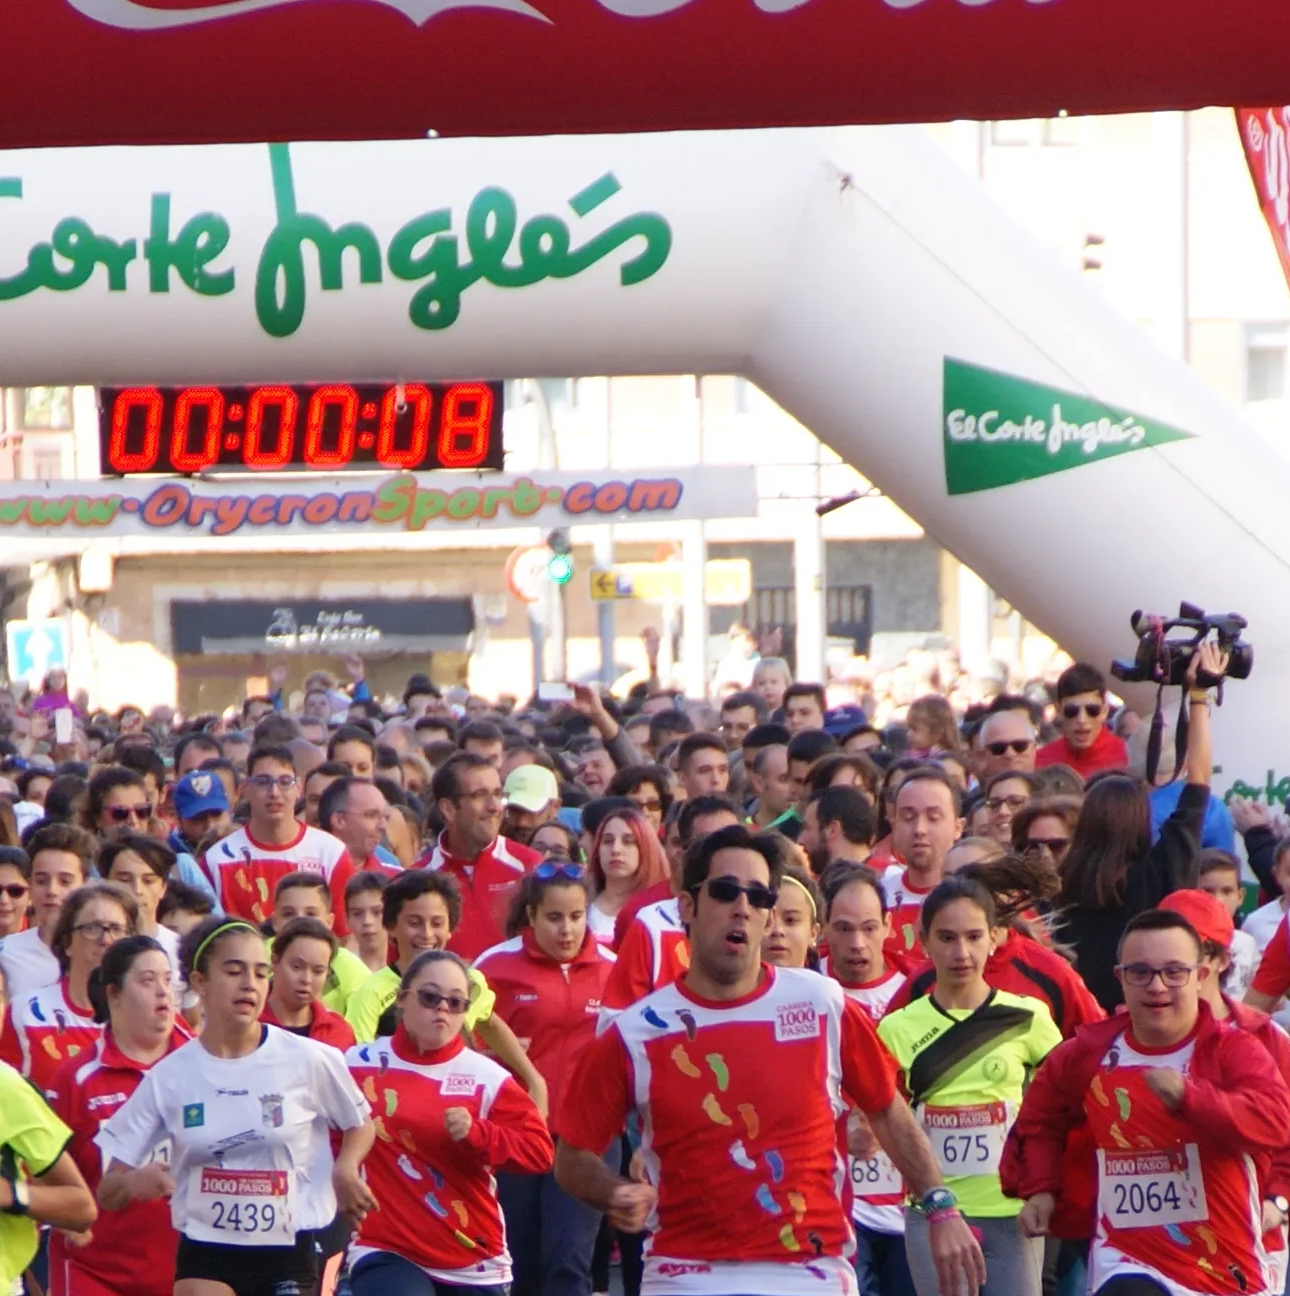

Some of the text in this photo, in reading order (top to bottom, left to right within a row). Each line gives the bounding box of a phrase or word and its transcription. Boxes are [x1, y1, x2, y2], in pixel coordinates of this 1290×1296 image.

[253, 142, 672, 338] Inglés
[109, 383, 494, 472] 00:00:08
[946, 403, 1146, 455] El Corte Inglés
[776, 1009, 816, 1028] 1000
[779, 1022, 817, 1037] PASOS
[925, 1113, 958, 1128] 1000
[943, 1134, 990, 1163] 675
[1105, 1159, 1135, 1175] 1000
[203, 1177, 237, 1194] 1000
[1113, 1180, 1182, 1215] 2064
[211, 1200, 276, 1233] 2439
